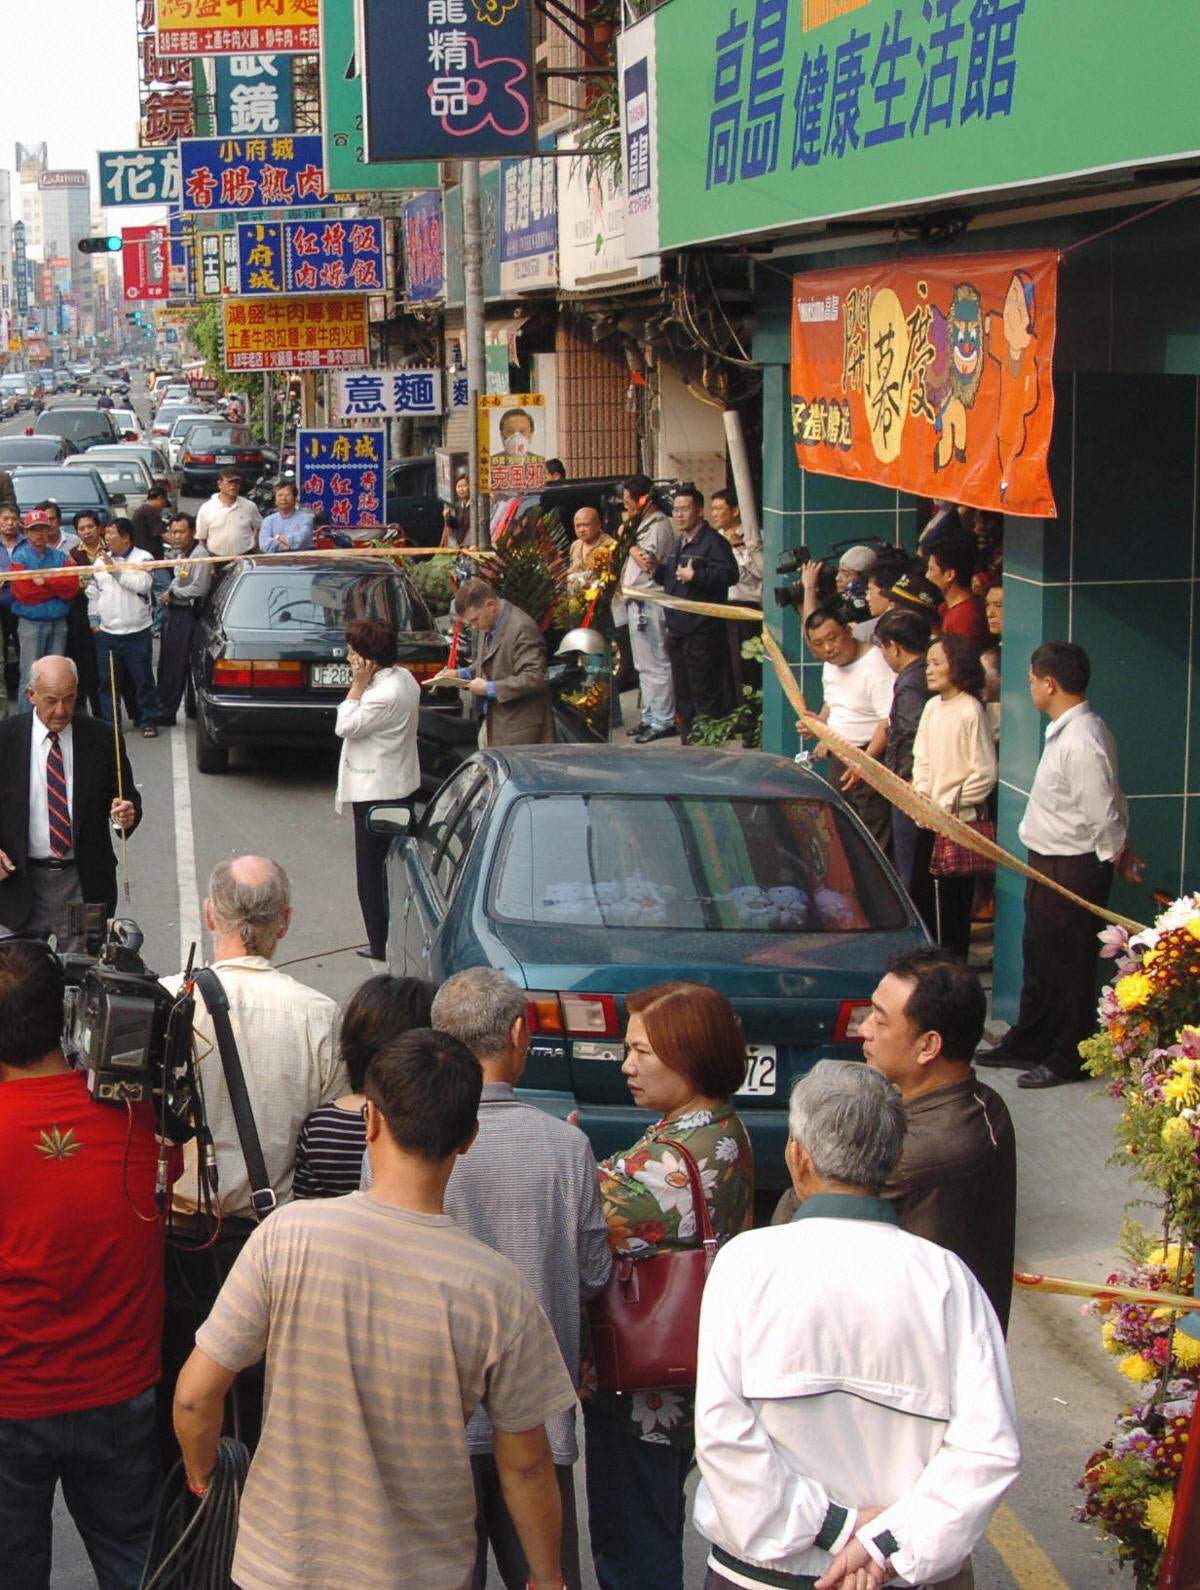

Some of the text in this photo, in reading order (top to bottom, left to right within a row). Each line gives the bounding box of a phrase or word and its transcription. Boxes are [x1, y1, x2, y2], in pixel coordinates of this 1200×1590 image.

[791, 0, 1026, 170] 健康生活館
[219, 139, 294, 162] 小府城
[185, 163, 325, 208] 香腸熟肉
[245, 224, 280, 292] 小府城
[345, 372, 437, 414] 意麵
[304, 435, 379, 462] 小府城
